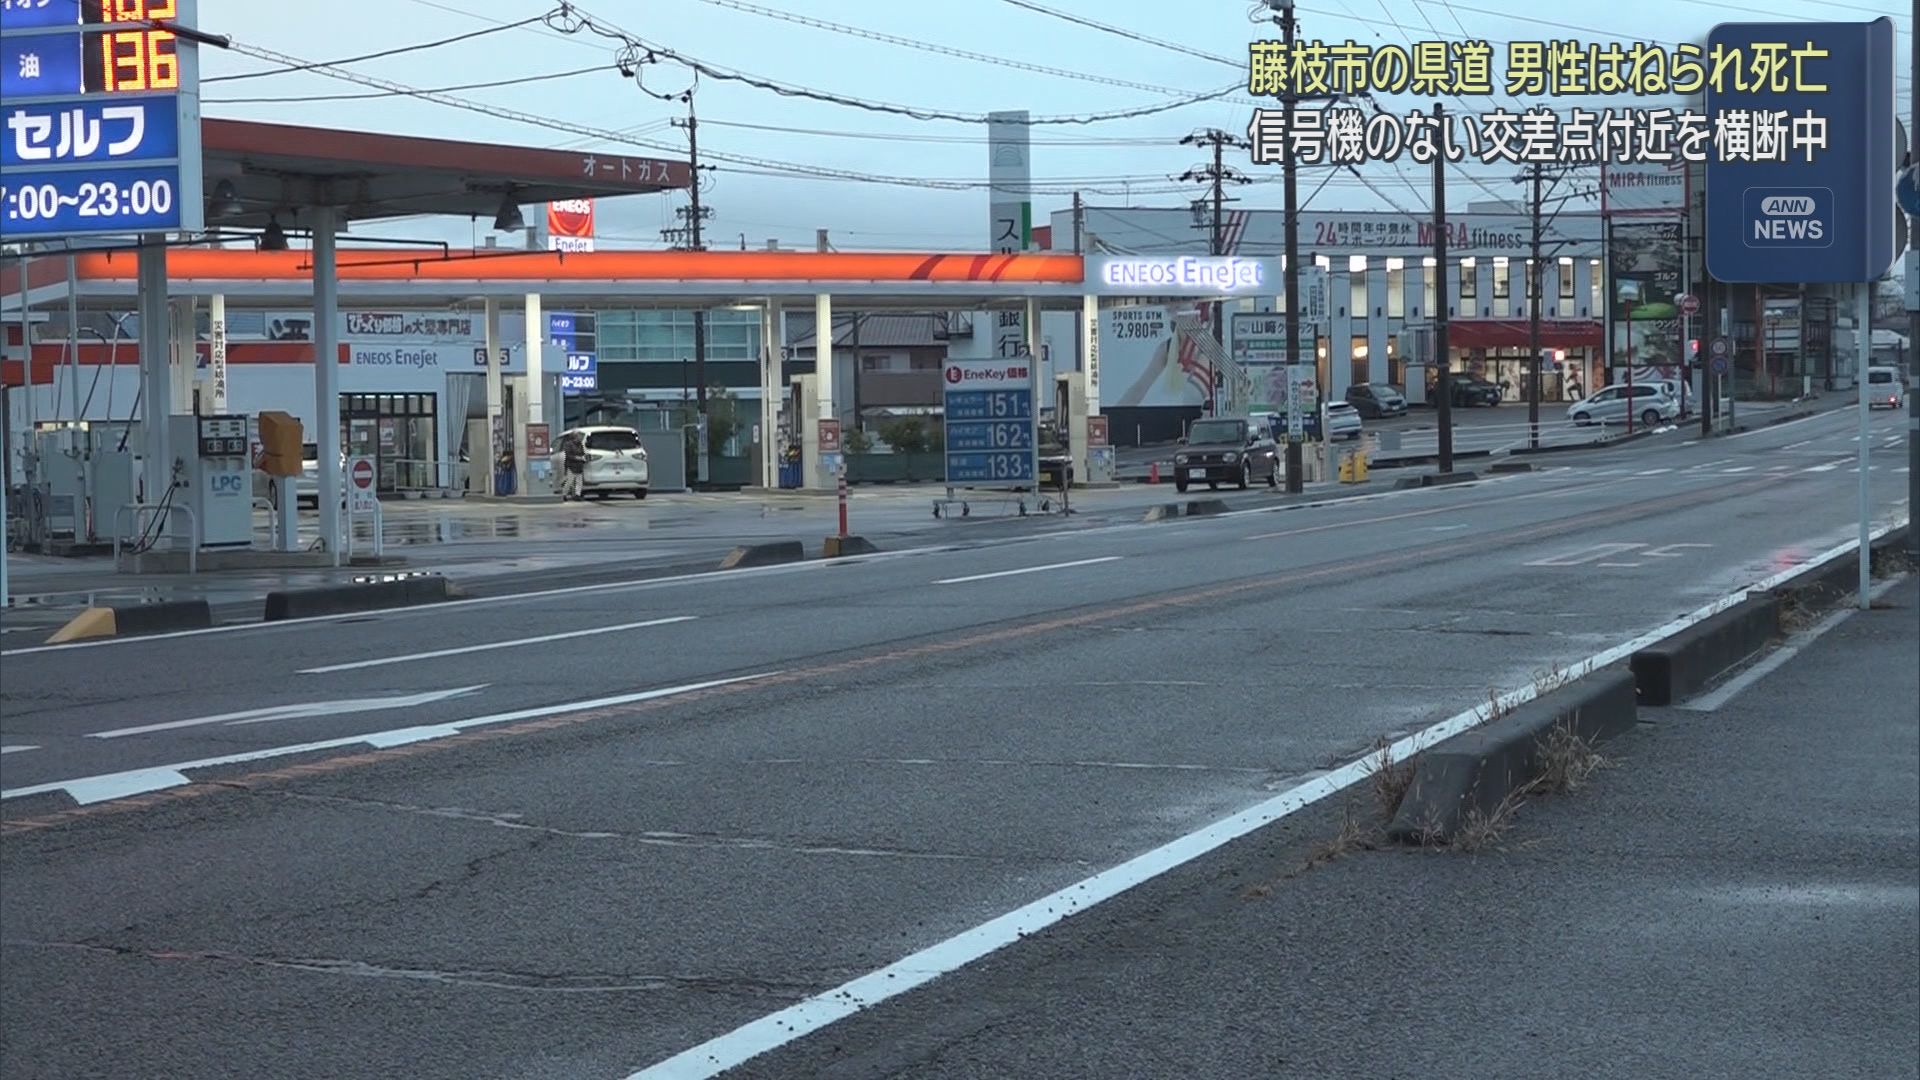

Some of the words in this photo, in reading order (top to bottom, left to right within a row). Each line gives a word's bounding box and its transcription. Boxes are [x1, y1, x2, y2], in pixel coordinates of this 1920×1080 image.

[19, 53, 40, 79] 油
[102, 31, 177, 91] 136
[8, 106, 145, 160] セルフ
[583, 155, 670, 182] オートガス
[1609, 172, 1645, 188] MIRA
[0, 179, 172, 220] :00~23:00
[1315, 222, 1337, 246] 24
[1472, 228, 1522, 248] fitness
[1110, 264, 1177, 283] ENEOS
[1183, 258, 1264, 289] Enejet
[1654, 272, 1678, 281] ゴルフ
[1112, 311, 1143, 320] SPORTS
[356, 351, 392, 365] ENEOS
[395, 349, 438, 368] Enejet
[964, 370, 1006, 381] EneKey
[986, 393, 1018, 416] 151
[987, 424, 1021, 447] 162
[988, 455, 1022, 478] 133
[211, 476, 242, 491] LPG
